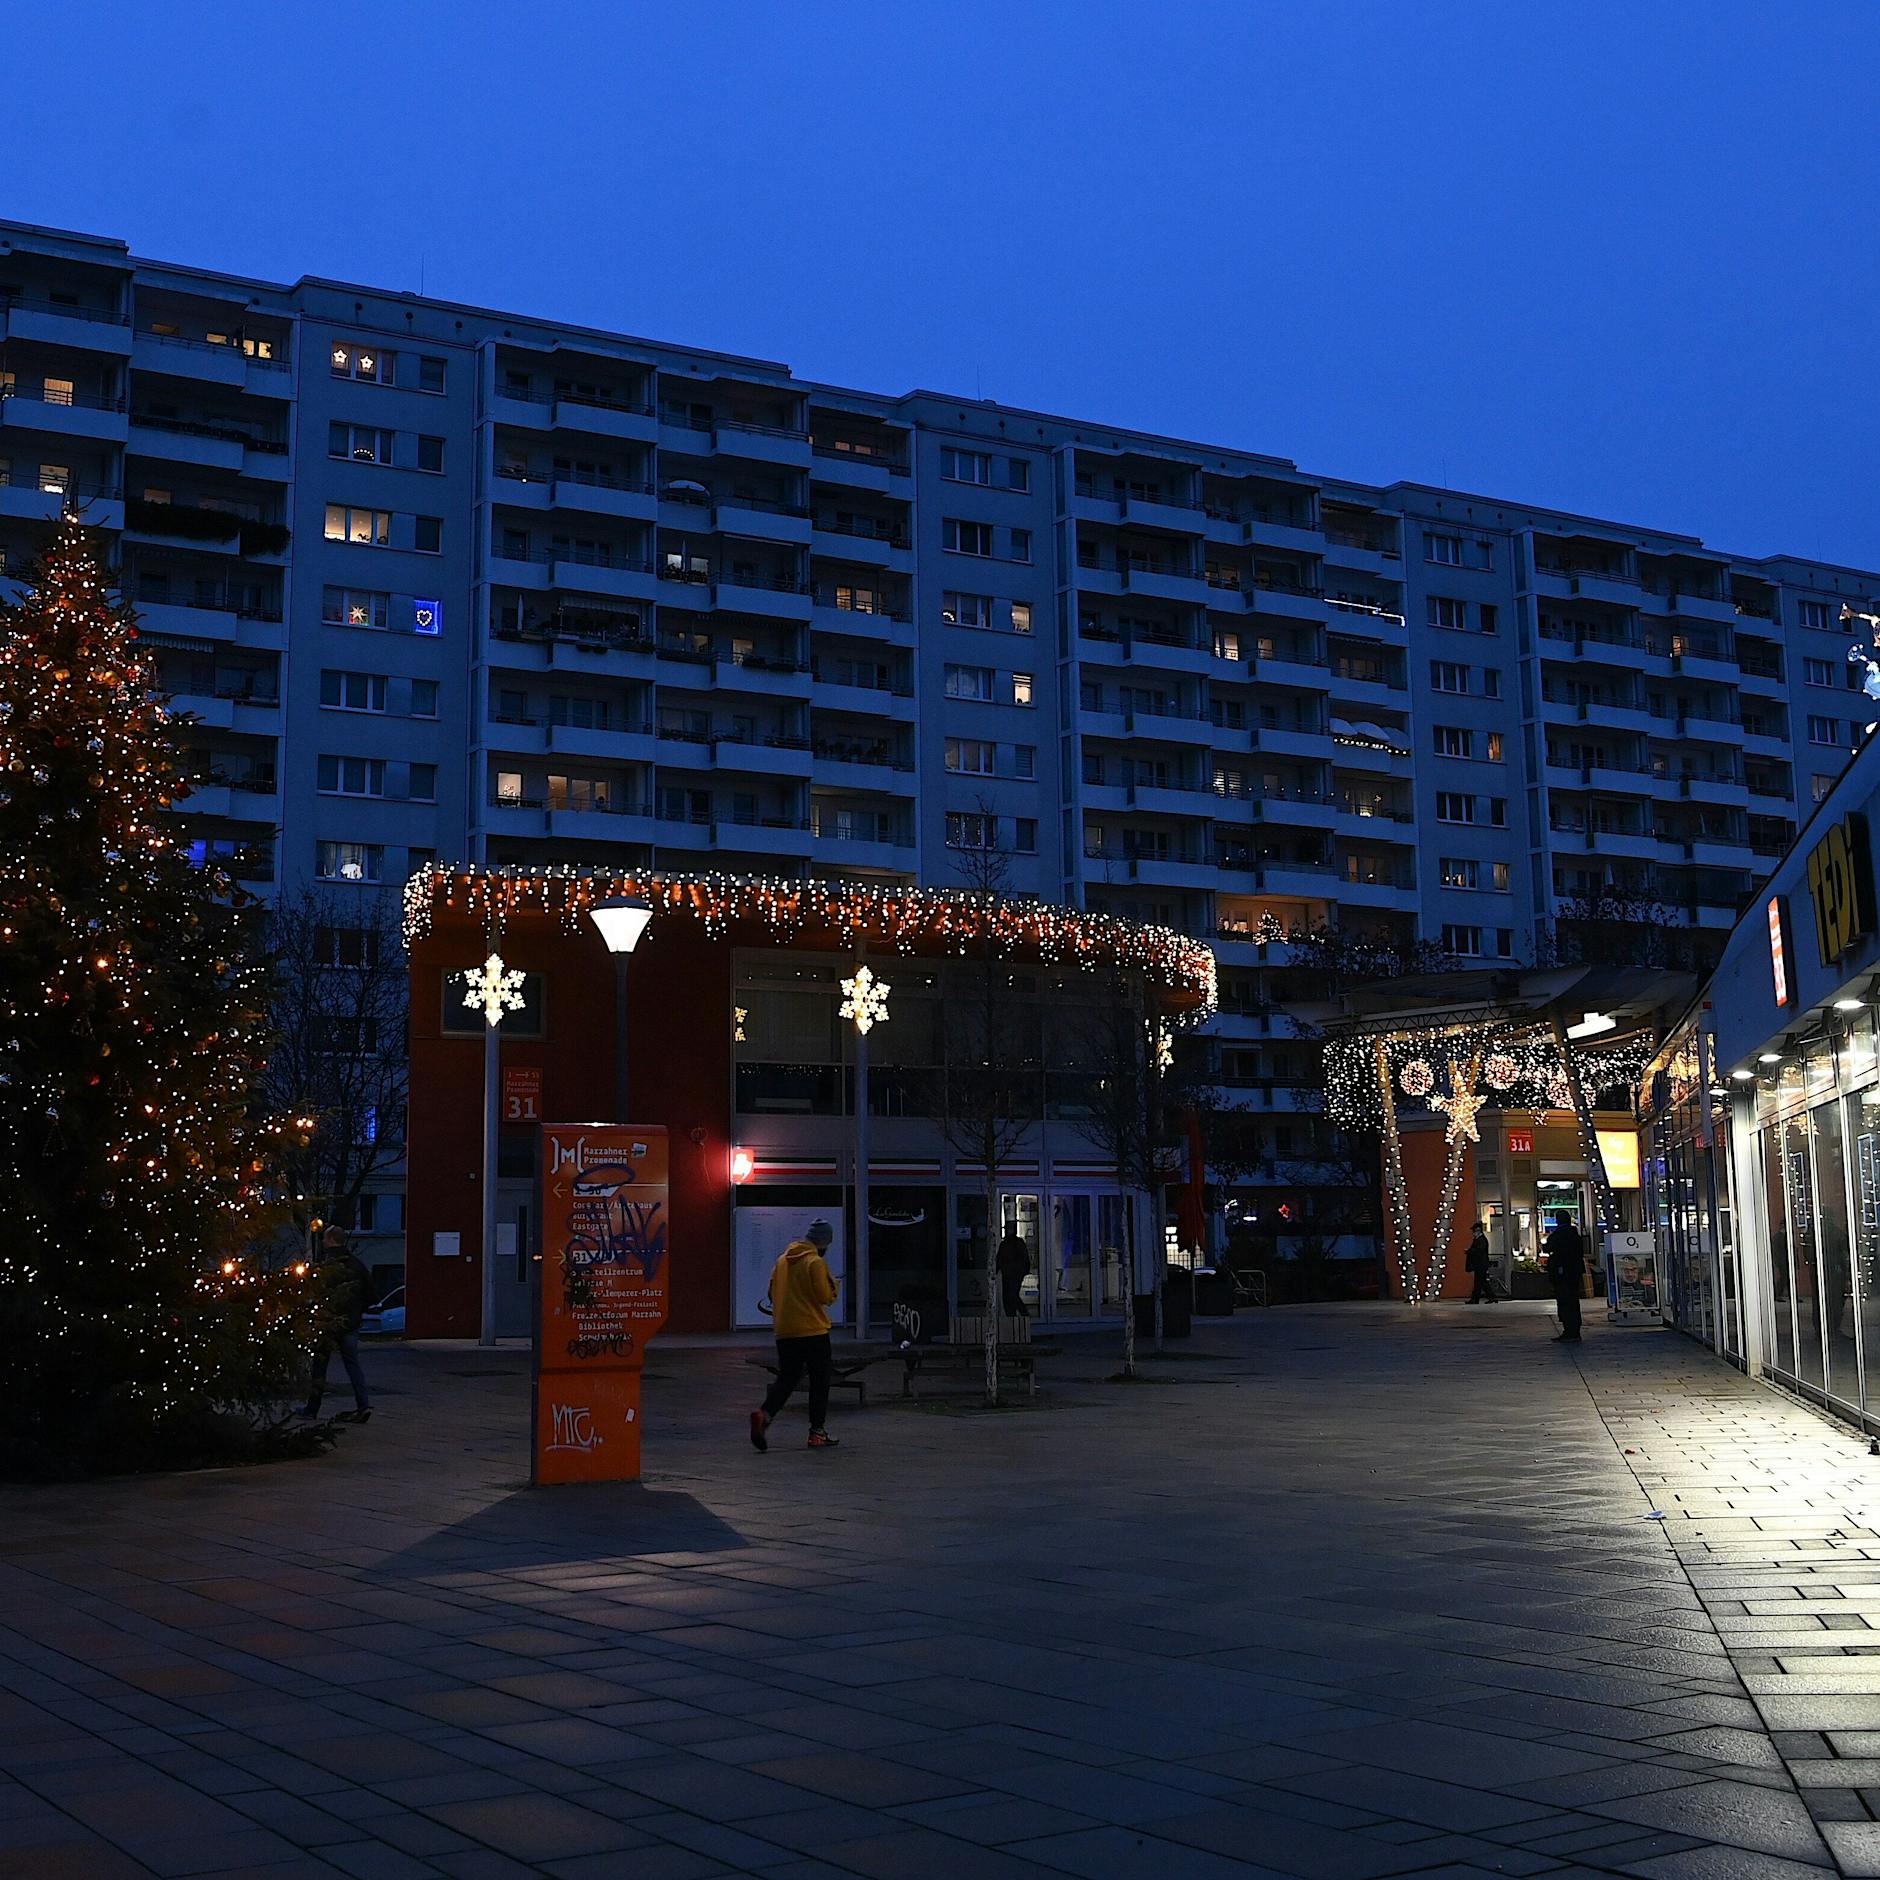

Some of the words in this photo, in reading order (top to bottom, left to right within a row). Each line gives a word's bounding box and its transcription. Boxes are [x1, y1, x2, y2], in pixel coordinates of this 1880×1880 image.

[508, 1096, 537, 1118] 31
[1511, 1138, 1531, 1151] 31A
[583, 1147, 627, 1155] Marzahner
[583, 1156, 627, 1164] Promenade
[572, 1223, 608, 1231] Eastgate
[631, 1310, 662, 1319] Marzahn
[578, 1321, 624, 1330] Bibliothek
